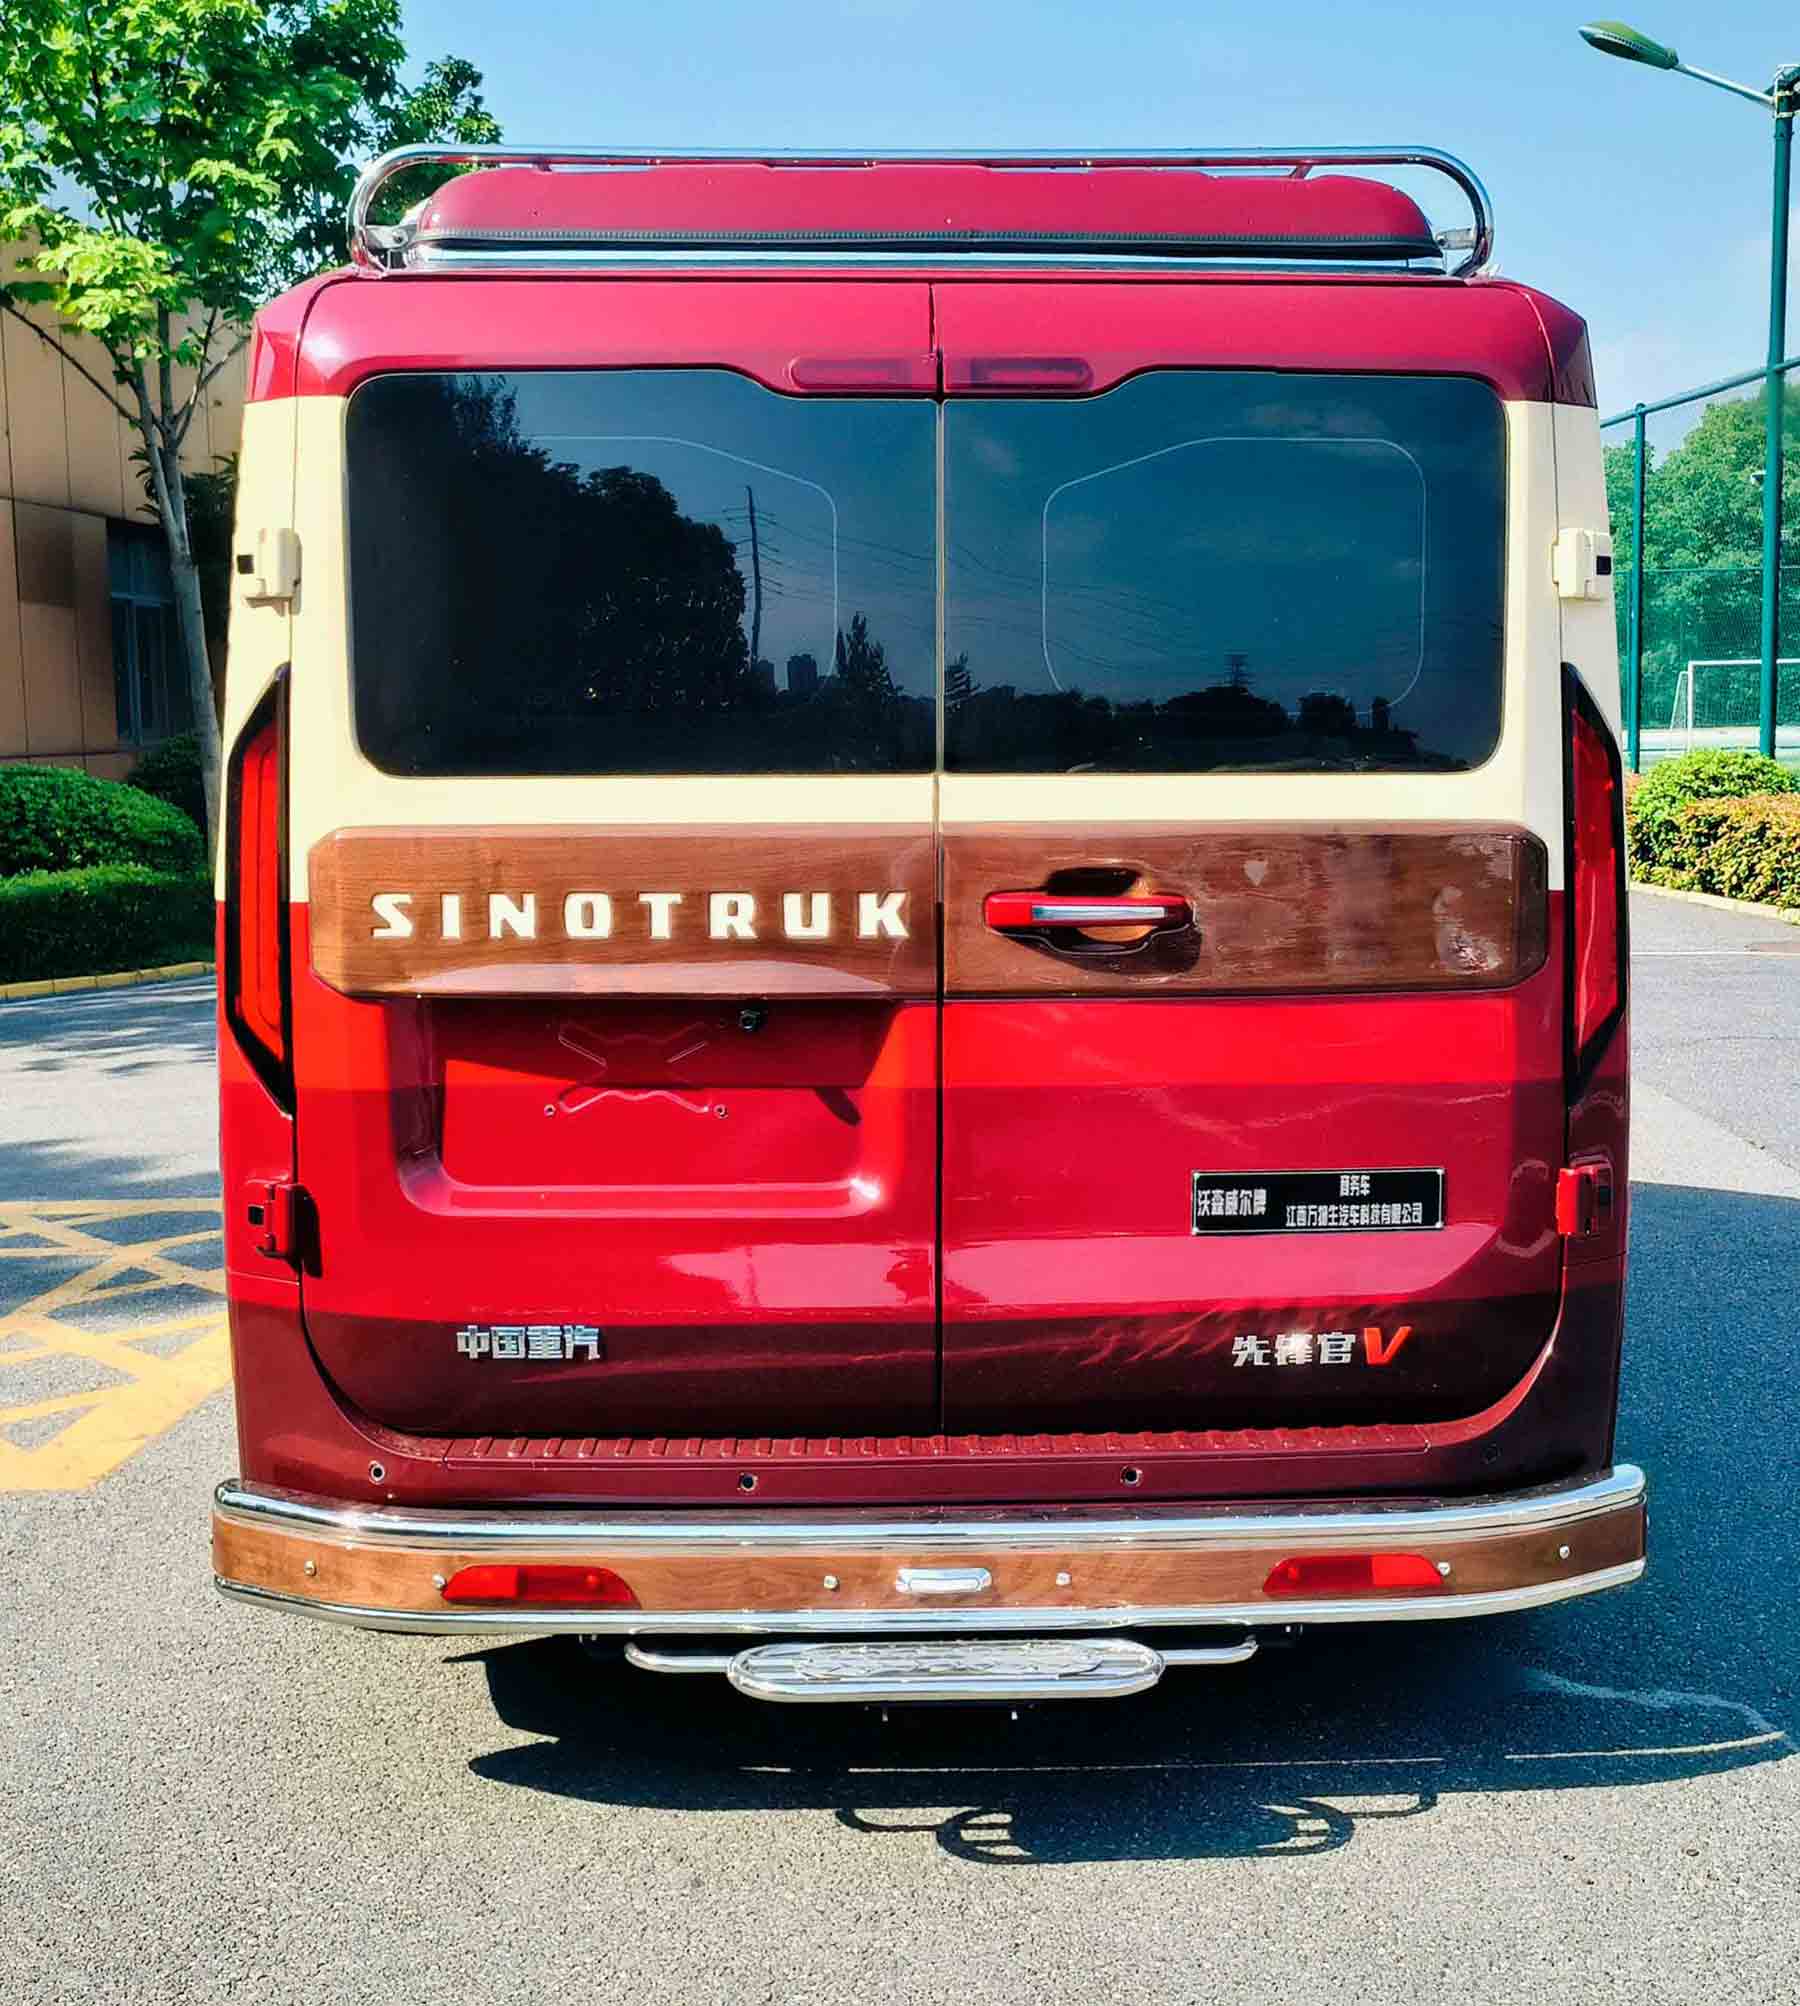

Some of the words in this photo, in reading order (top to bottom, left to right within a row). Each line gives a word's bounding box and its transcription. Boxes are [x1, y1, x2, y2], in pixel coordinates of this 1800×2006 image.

[370, 892, 910, 940] SINOTRUK
[1339, 1174, 1371, 1198] 商务车
[456, 1324, 601, 1361] 中国重汽
